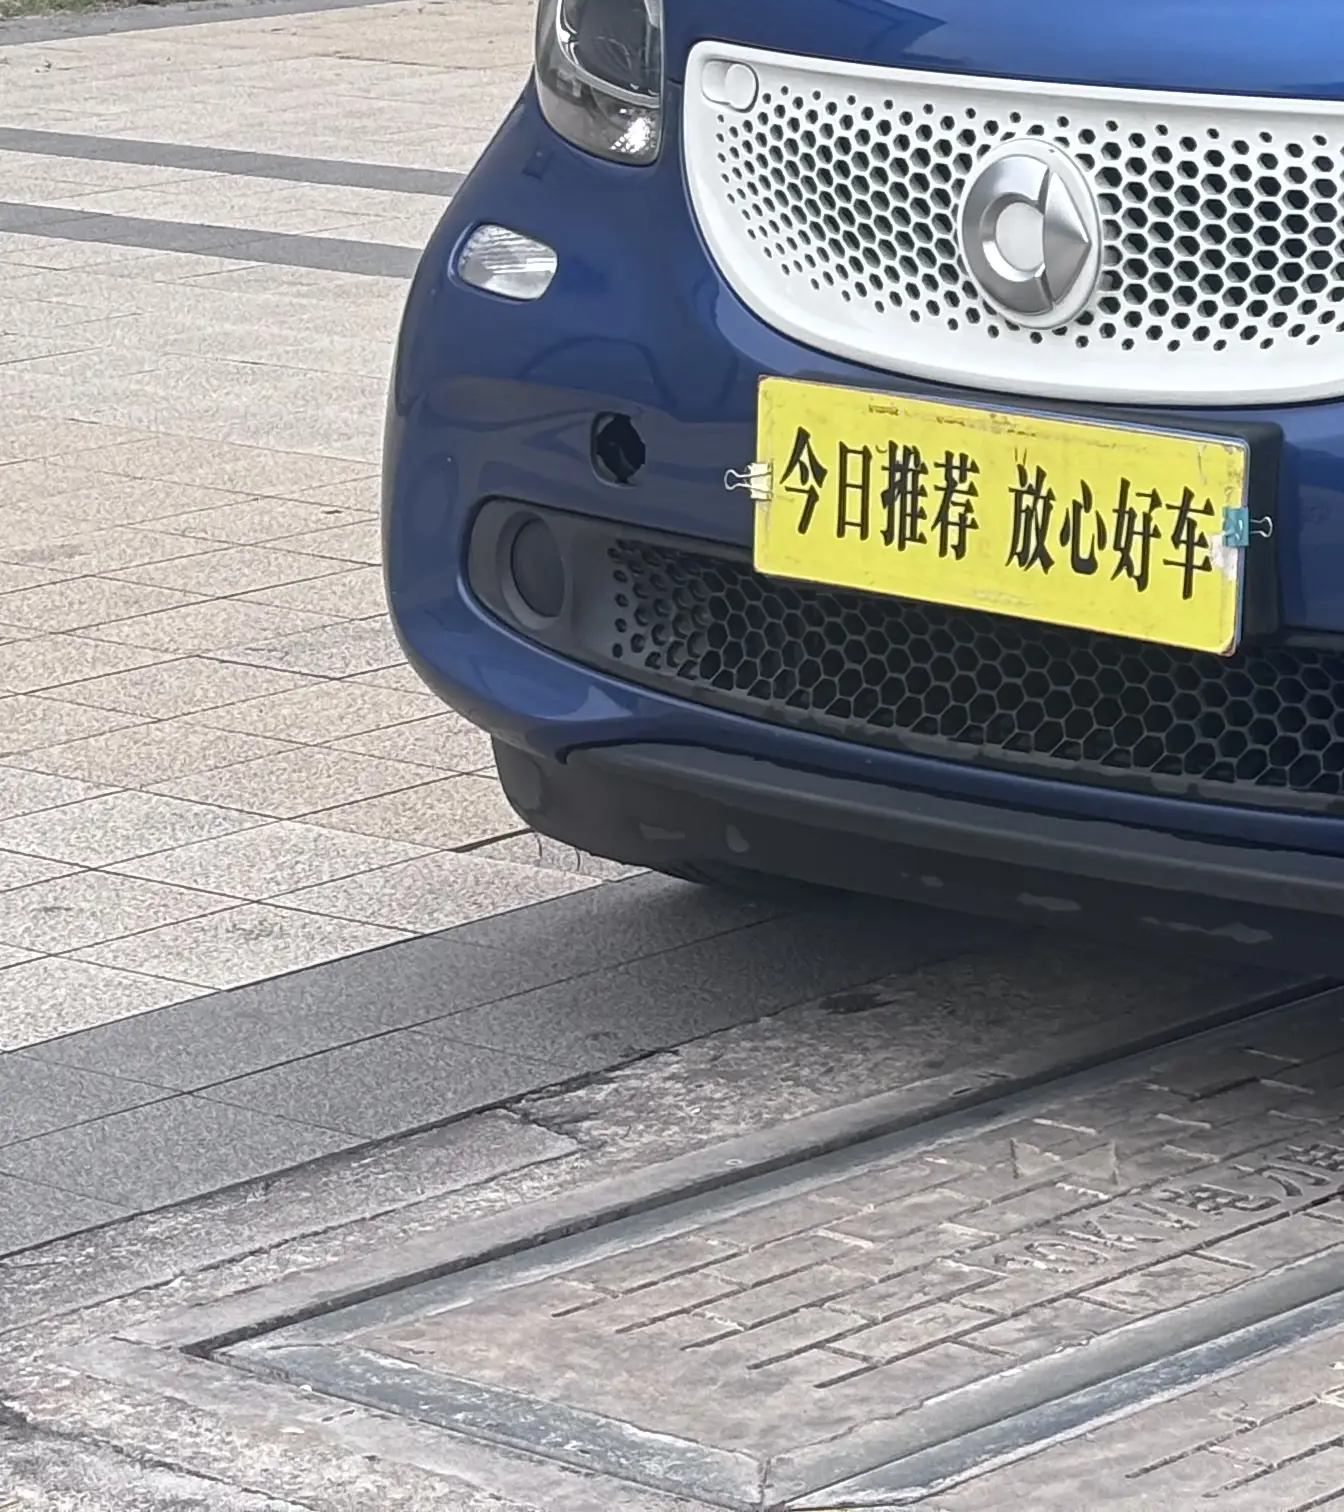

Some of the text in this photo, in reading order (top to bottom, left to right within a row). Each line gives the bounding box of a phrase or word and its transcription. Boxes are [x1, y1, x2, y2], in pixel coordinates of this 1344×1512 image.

[778, 424, 1215, 601] 今日推荐 放心好车
